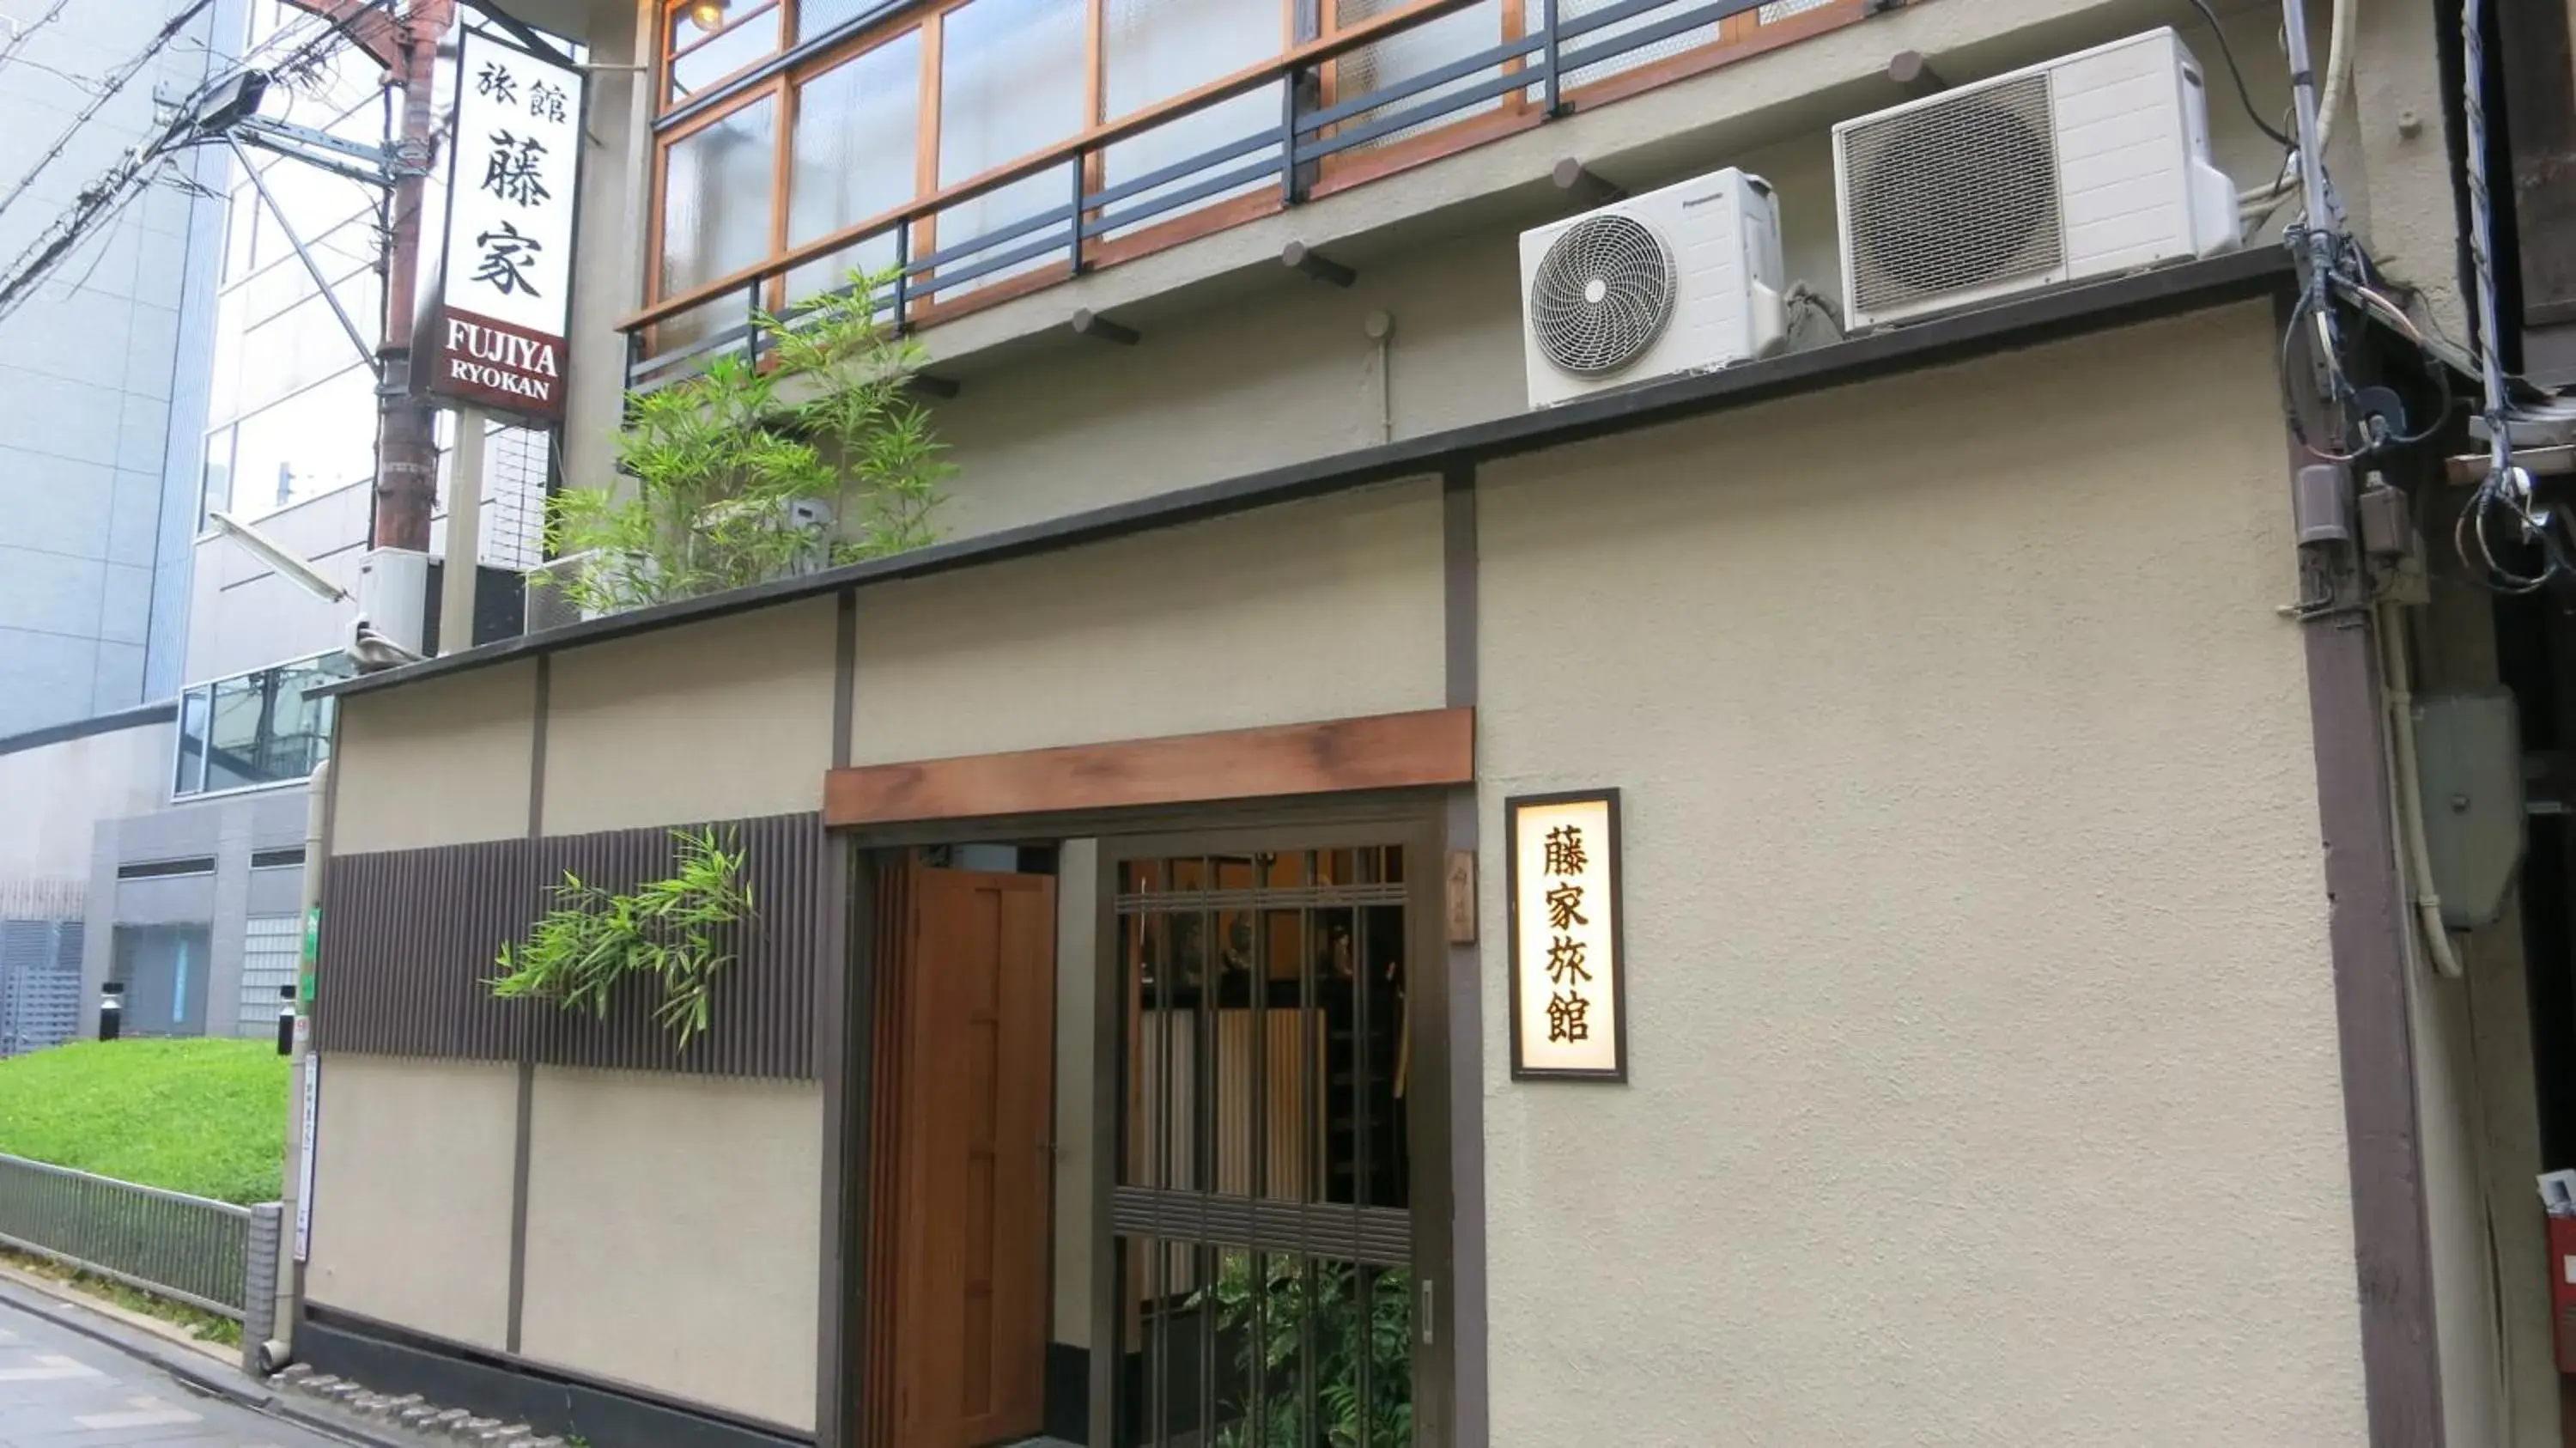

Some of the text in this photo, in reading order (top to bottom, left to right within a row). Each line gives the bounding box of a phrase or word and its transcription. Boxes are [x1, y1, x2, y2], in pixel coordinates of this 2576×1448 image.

[478, 62, 567, 125] 旅館
[471, 129, 551, 298] 藤家
[446, 318, 558, 377] FUJIYA
[451, 358, 550, 401] RYOKAN
[1545, 824, 1592, 1043] 藤家旅館
